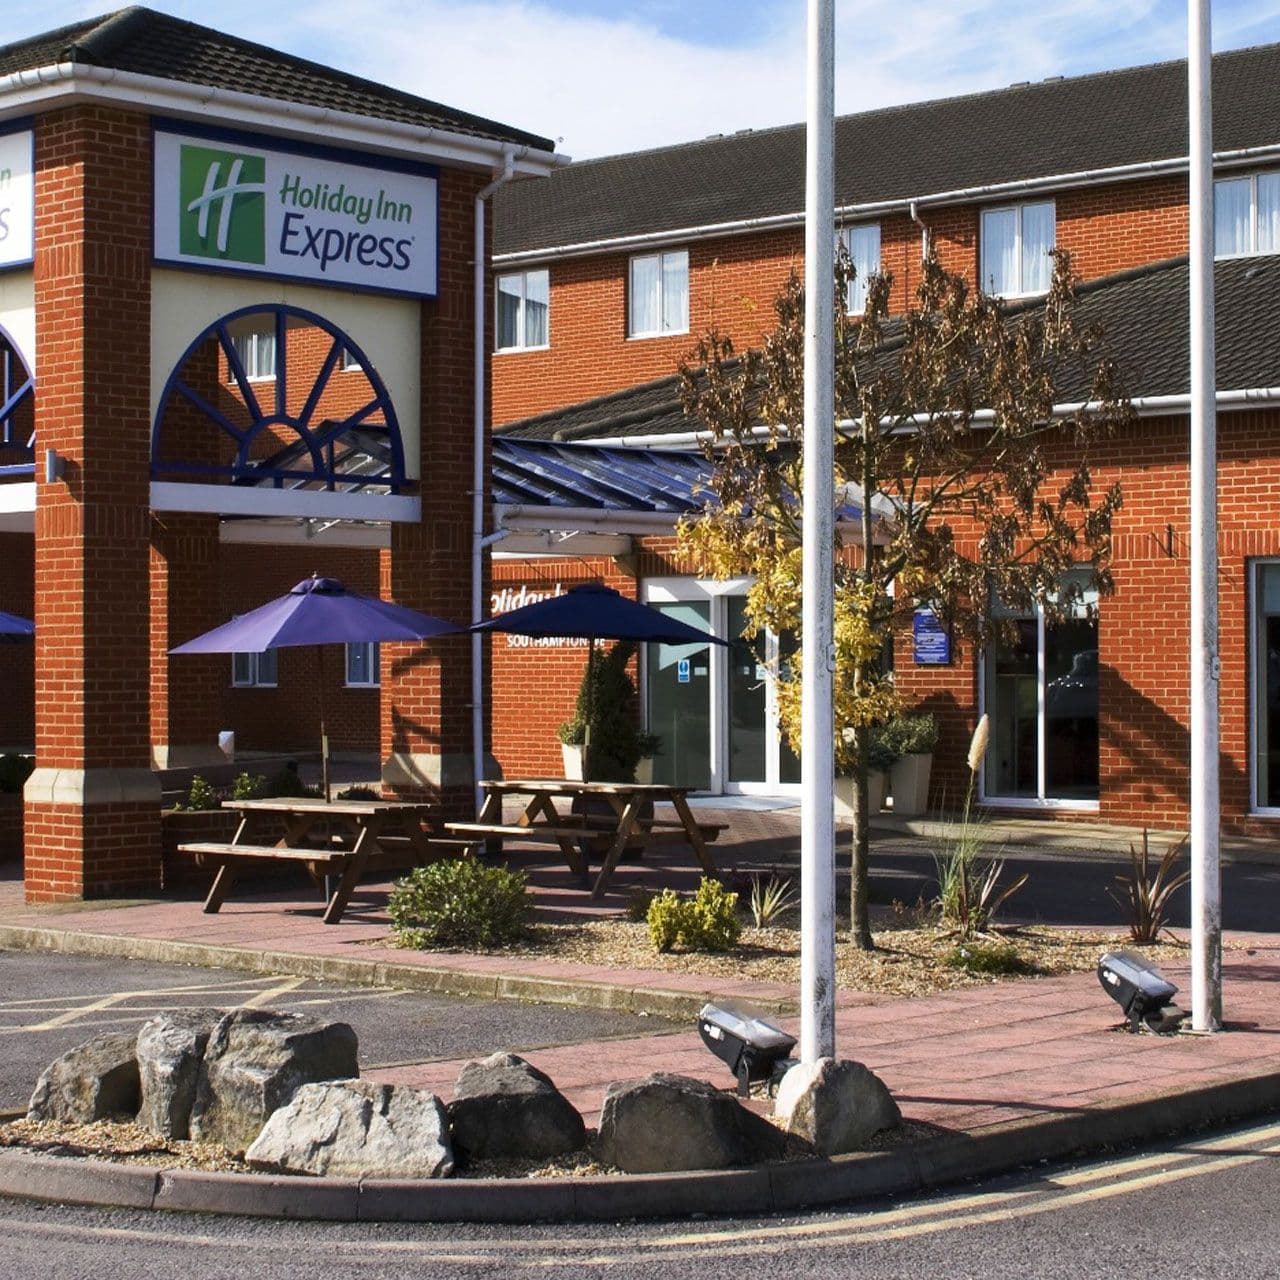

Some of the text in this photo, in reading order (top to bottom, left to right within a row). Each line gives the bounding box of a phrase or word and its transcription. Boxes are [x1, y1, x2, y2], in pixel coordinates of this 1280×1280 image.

[188, 159, 266, 252] H
[279, 174, 413, 224] Holiday Inn
[279, 211, 413, 272] Express
[490, 584, 551, 613] olida
